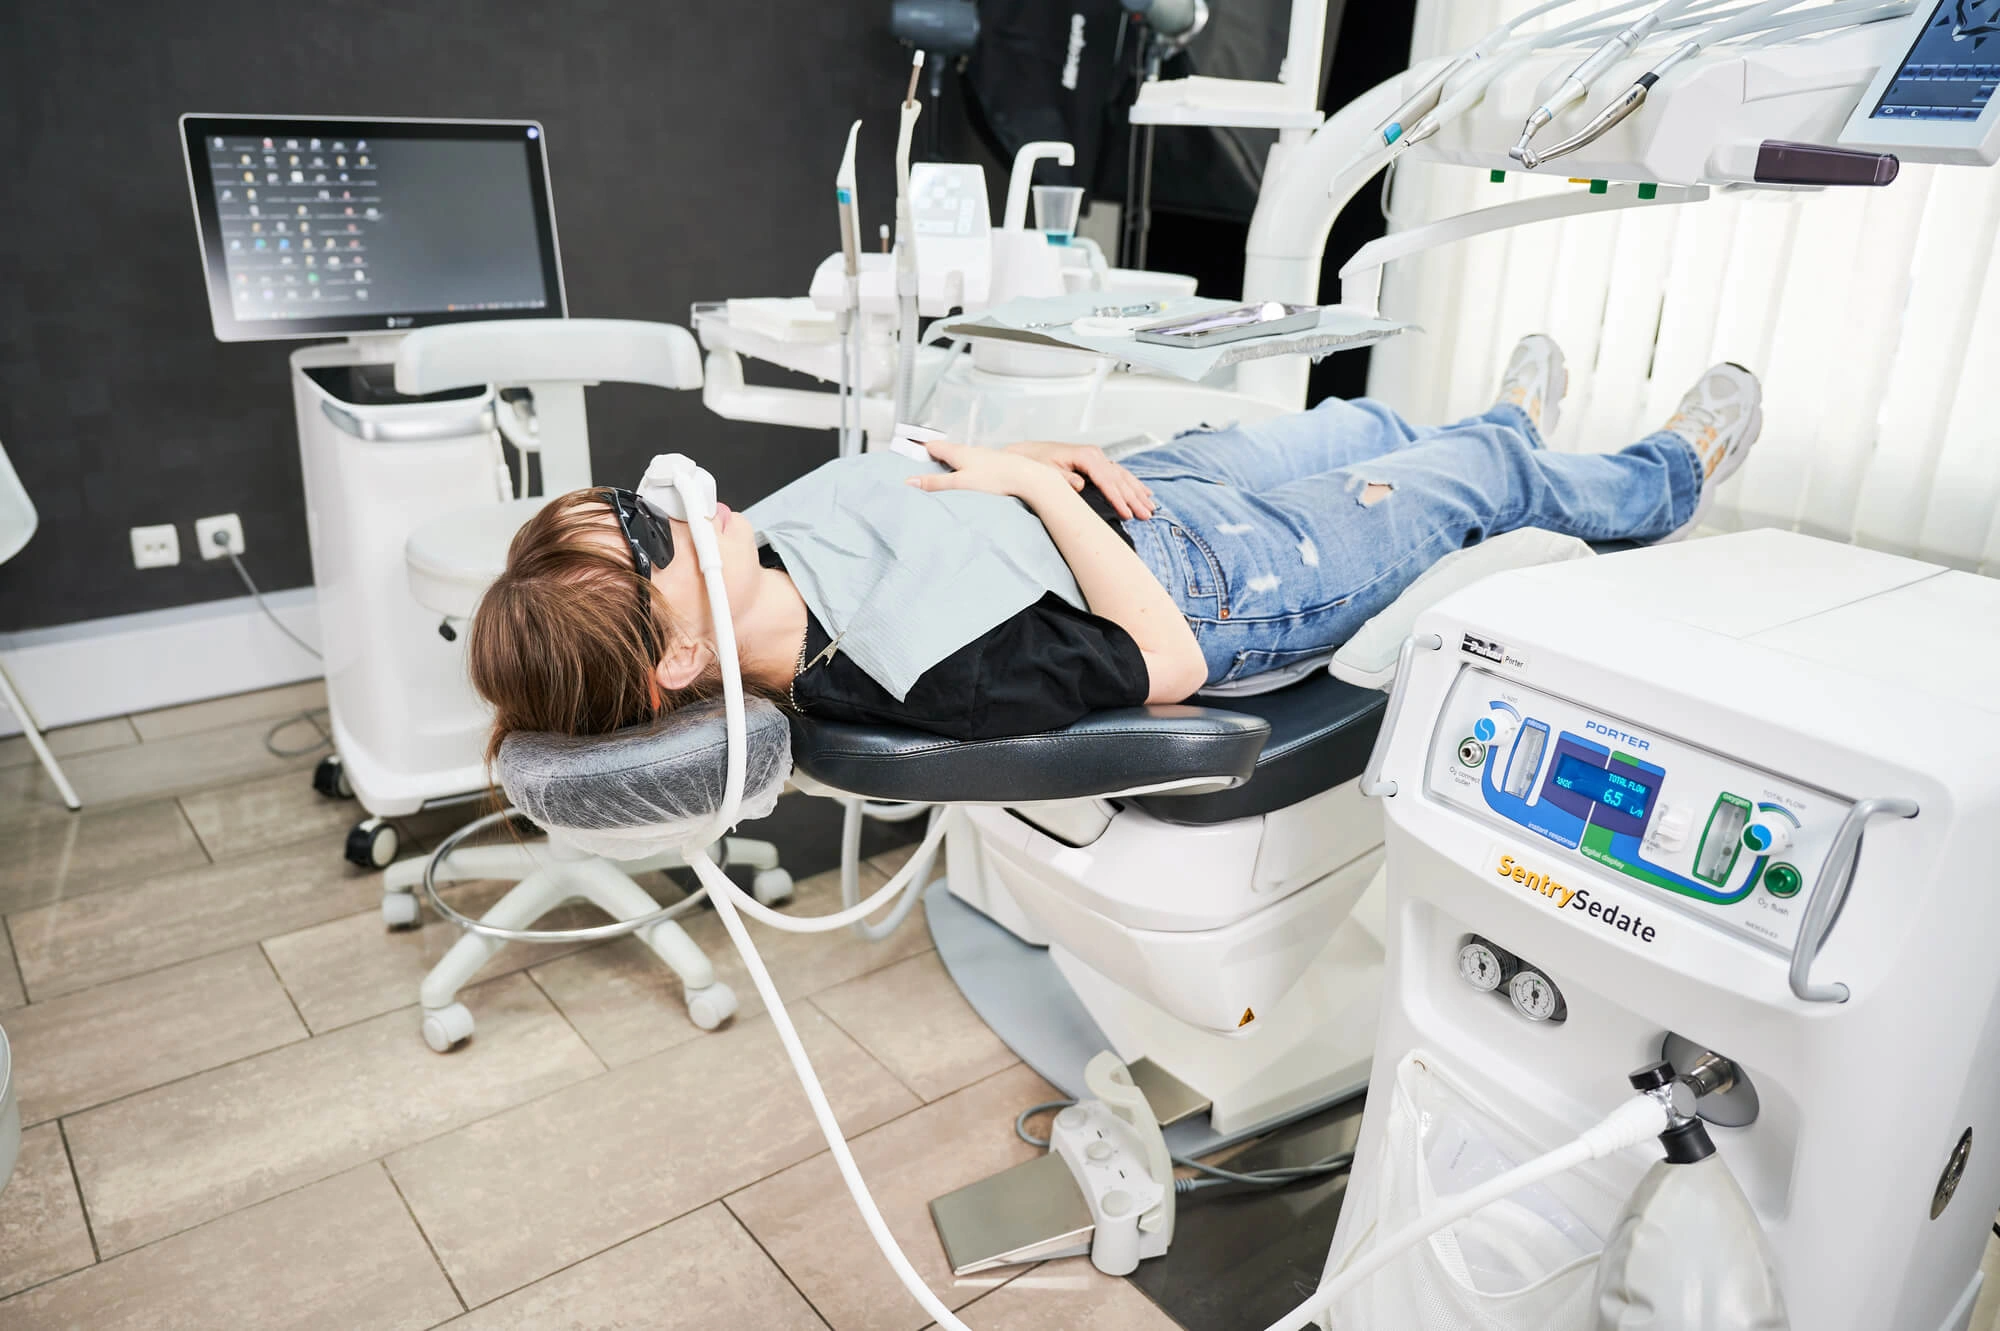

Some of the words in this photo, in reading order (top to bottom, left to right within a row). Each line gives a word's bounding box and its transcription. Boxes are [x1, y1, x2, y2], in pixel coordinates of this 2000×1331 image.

[1504, 655, 1524, 668] Porter
[1585, 720, 1650, 750] PORTER
[1608, 773, 1627, 788] TOTAL
[1628, 781, 1646, 794] FLOW
[1603, 788, 1624, 807] 6.5
[1722, 793, 1750, 807] oxygen
[1527, 821, 1549, 837] instant
[1549, 830, 1577, 848] response
[1581, 845, 1602, 860] digital
[1601, 852, 1625, 870] display
[1496, 855, 1656, 943] SentrySedate
